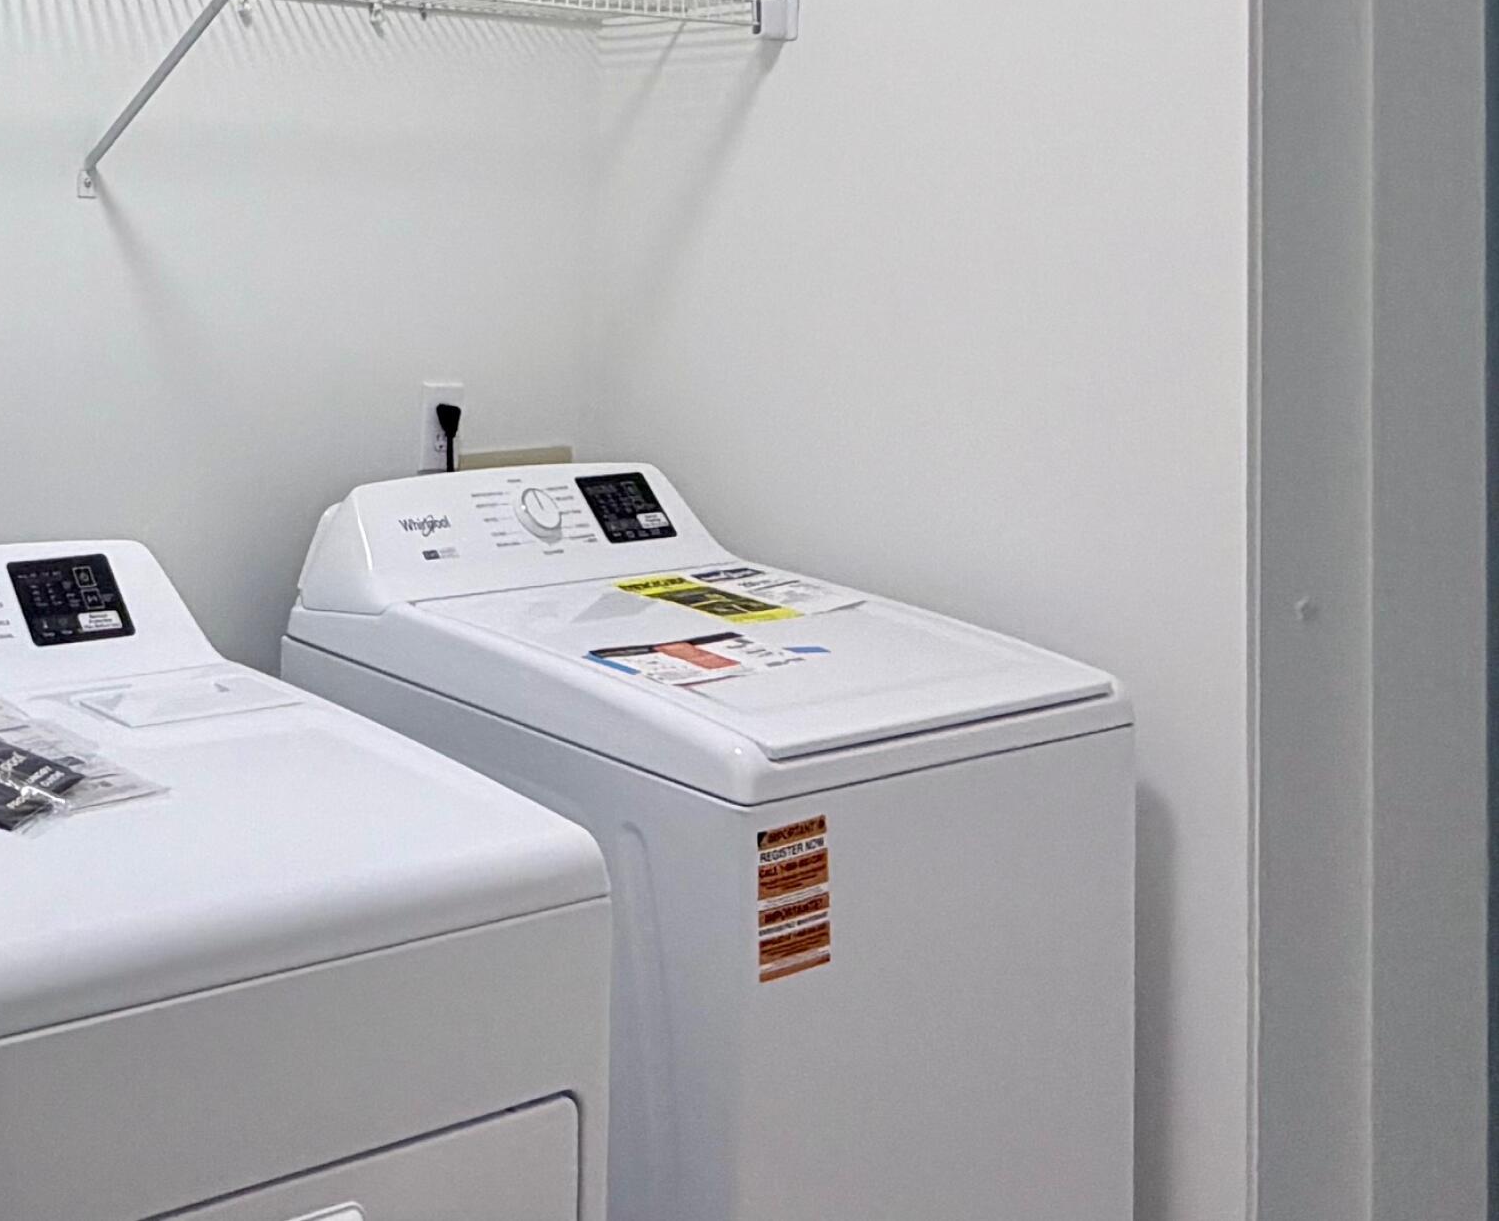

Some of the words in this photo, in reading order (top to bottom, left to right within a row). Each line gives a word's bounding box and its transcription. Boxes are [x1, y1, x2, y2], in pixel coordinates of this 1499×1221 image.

[398, 514, 451, 537] Whirlpool
[760, 842, 804, 862] REGISTER
[805, 836, 825, 851] NOW
